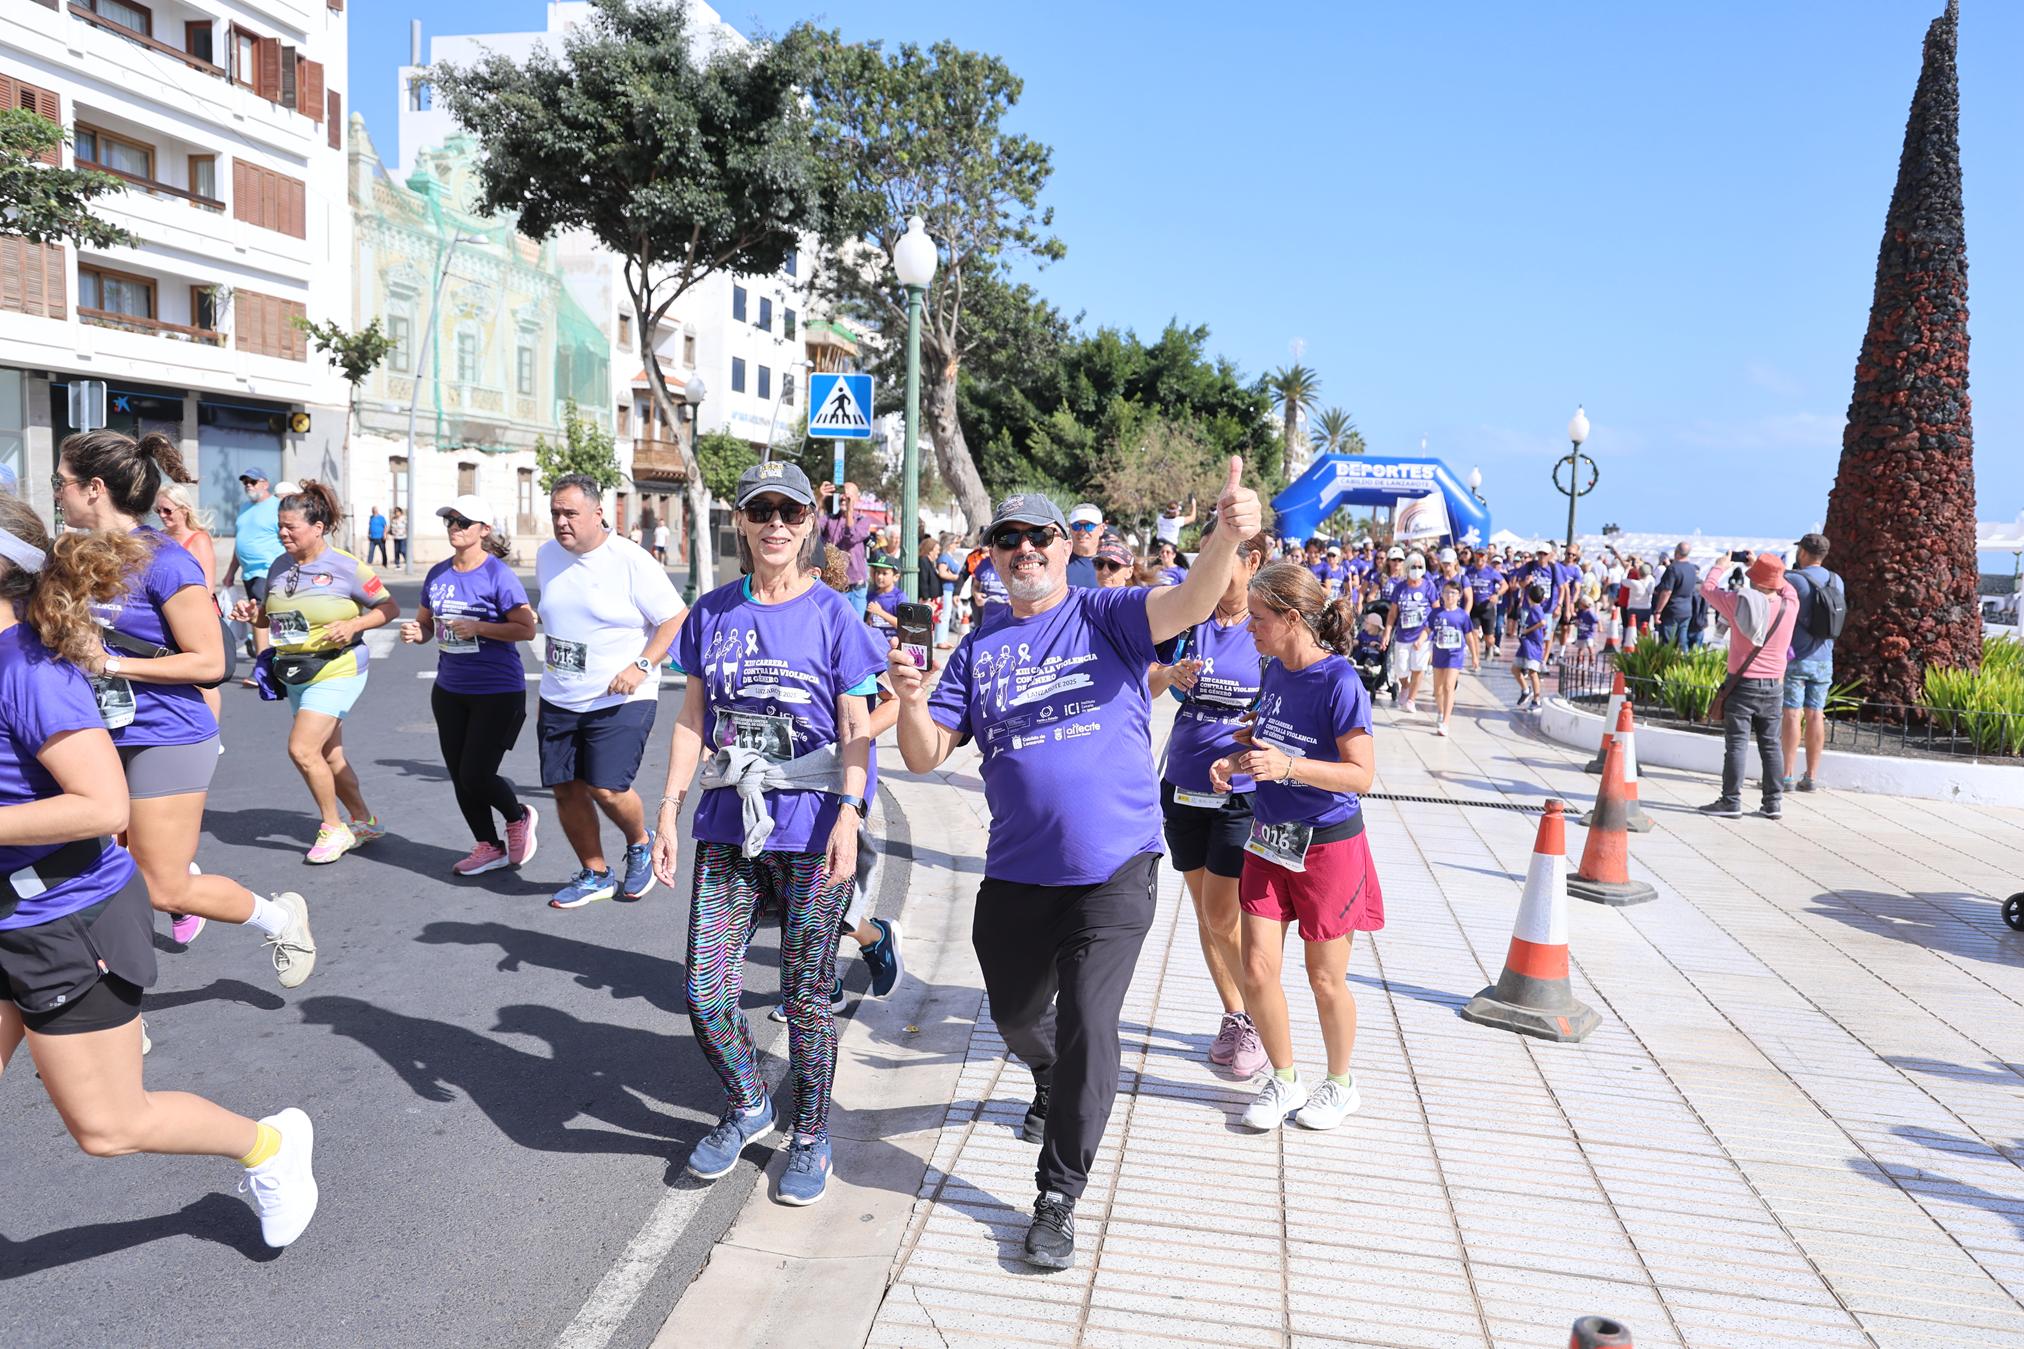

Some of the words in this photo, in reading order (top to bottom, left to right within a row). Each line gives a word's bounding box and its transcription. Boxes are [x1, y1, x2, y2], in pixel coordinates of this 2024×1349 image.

[1336, 463, 1434, 479] DEPORTES
[1340, 478, 1373, 486] CABILDO
[1386, 479, 1430, 488] LANZAROTE
[552, 650, 574, 665] 016
[756, 660, 788, 668] CARRERA
[1016, 667, 1030, 676] XIII
[1044, 665, 1057, 674] LA
[743, 676, 753, 684] DE
[1062, 679, 1077, 688] 2025
[1211, 678, 1239, 686] CARRERA
[1200, 682, 1224, 690] CONTRA
[1207, 688, 1232, 697] GÉNERO
[1275, 719, 1293, 731] CARRERA
[1265, 723, 1281, 733] CONTRA
[1286, 730, 1318, 744] VIOLENCIA
[733, 735, 768, 753] 112
[1261, 823, 1290, 850] 016
